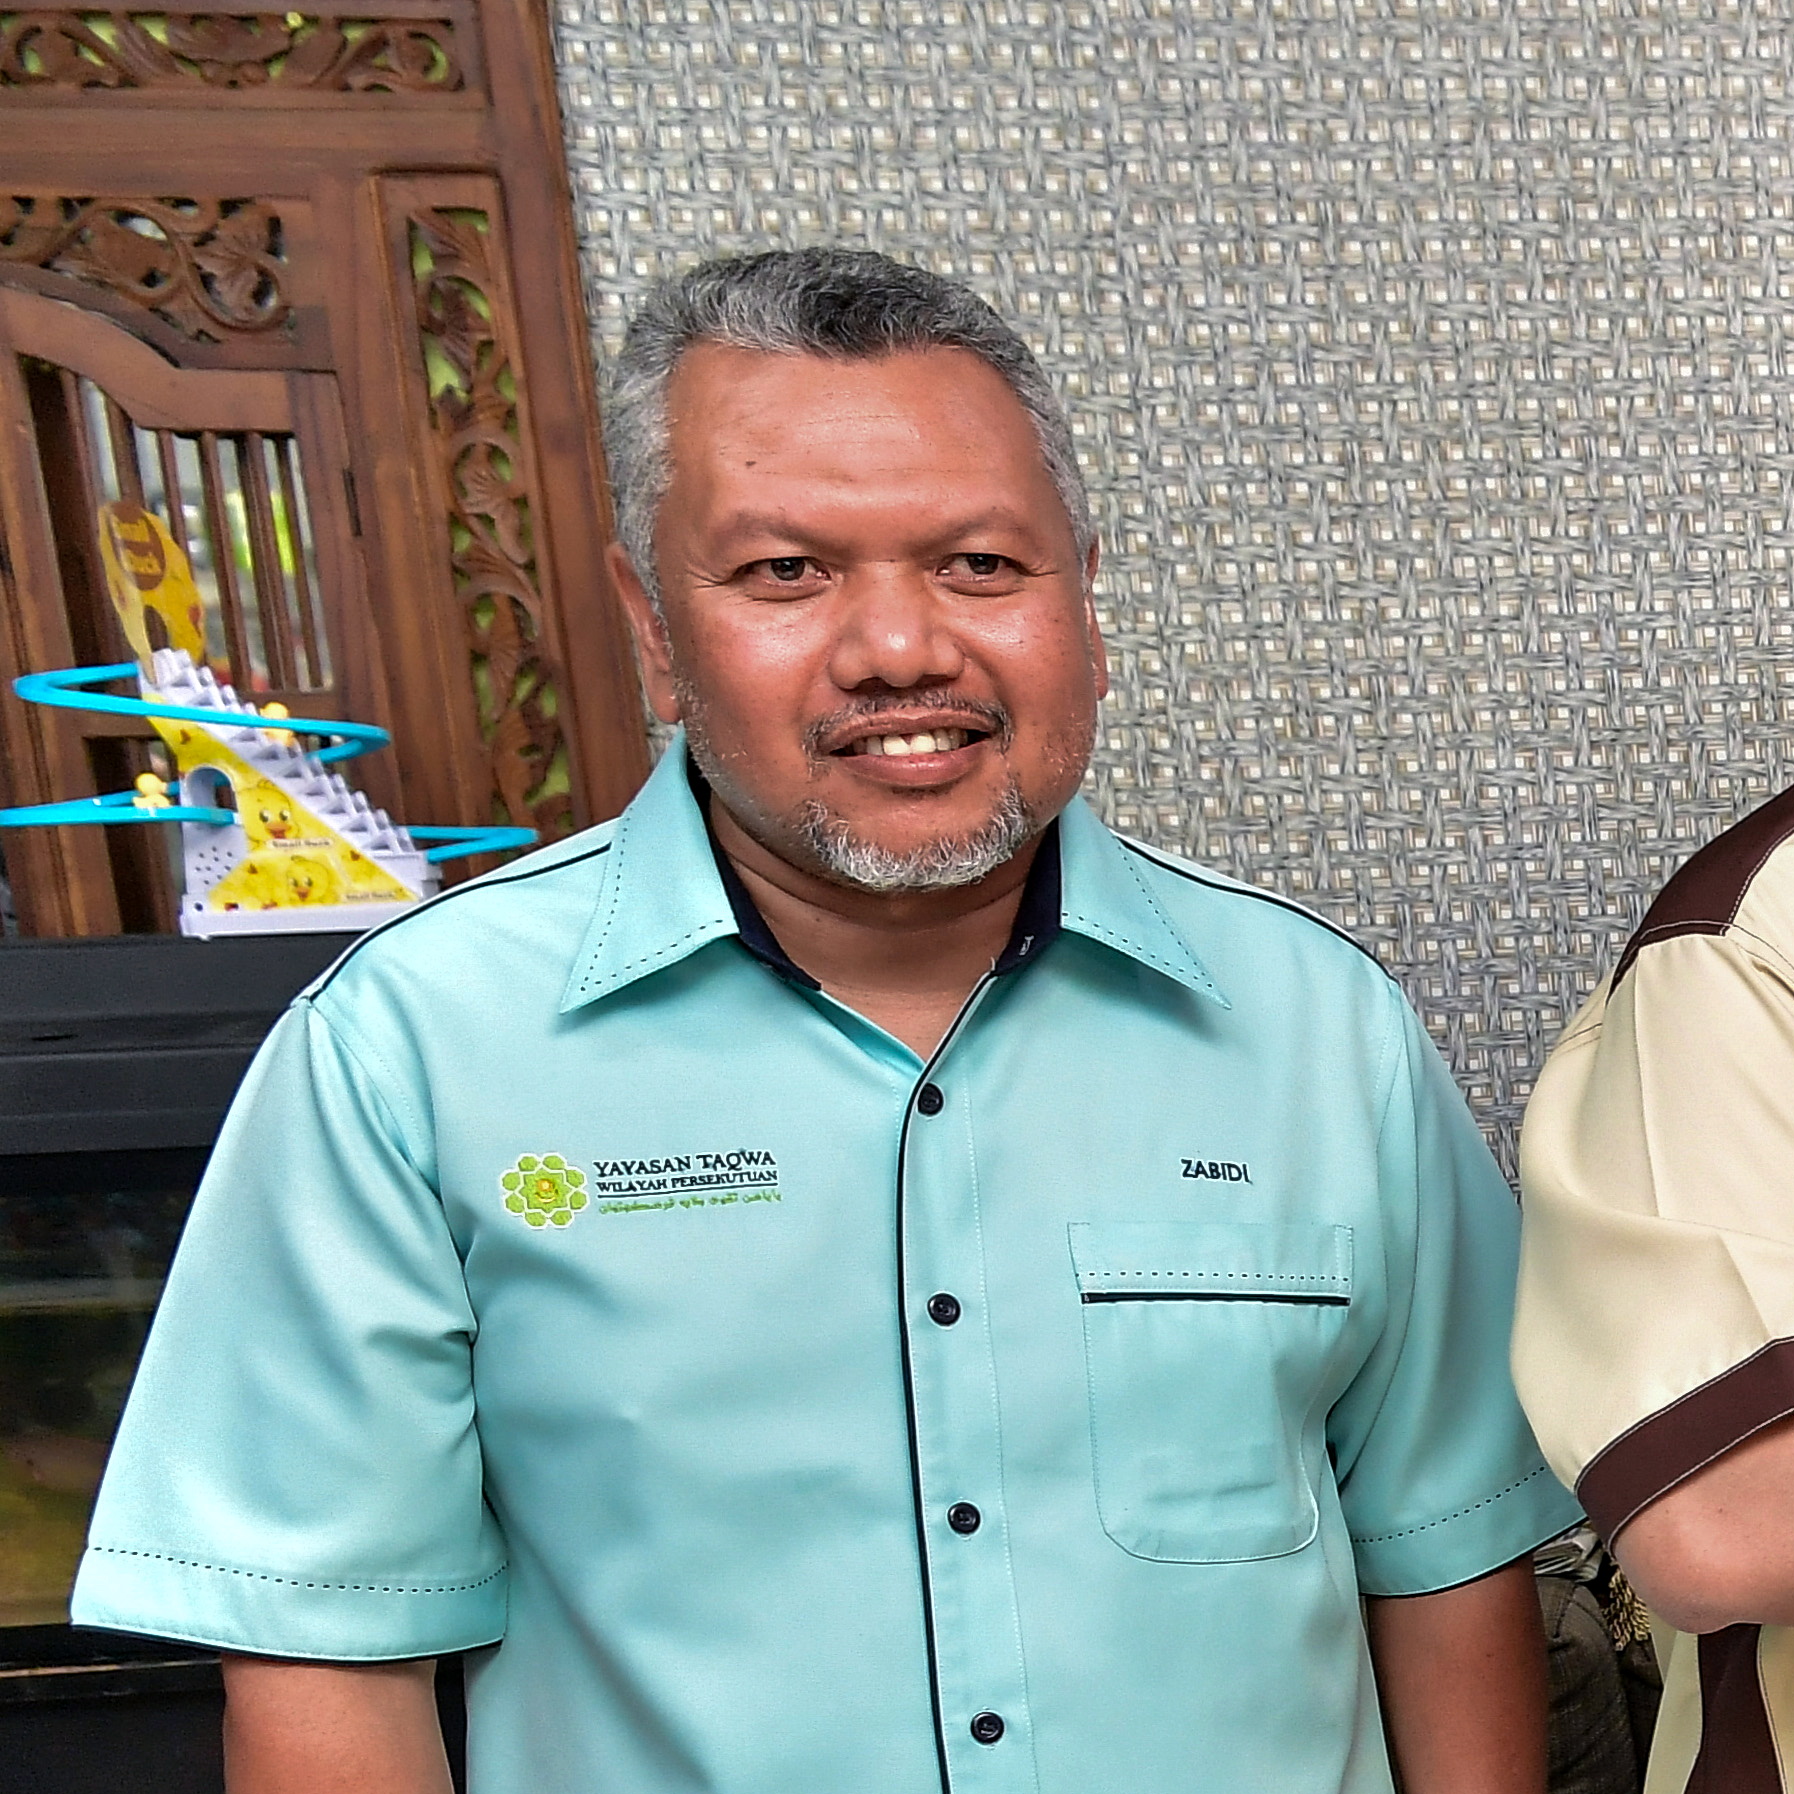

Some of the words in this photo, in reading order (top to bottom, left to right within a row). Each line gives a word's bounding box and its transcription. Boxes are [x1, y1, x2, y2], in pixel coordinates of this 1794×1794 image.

[594, 1156, 692, 1177] YAYASAN
[696, 1151, 777, 1172] TAQWA
[1181, 1159, 1252, 1184] ZABIDI
[596, 1178, 667, 1193] WILAYAH
[671, 1171, 778, 1188] PERSEKUTUAN
